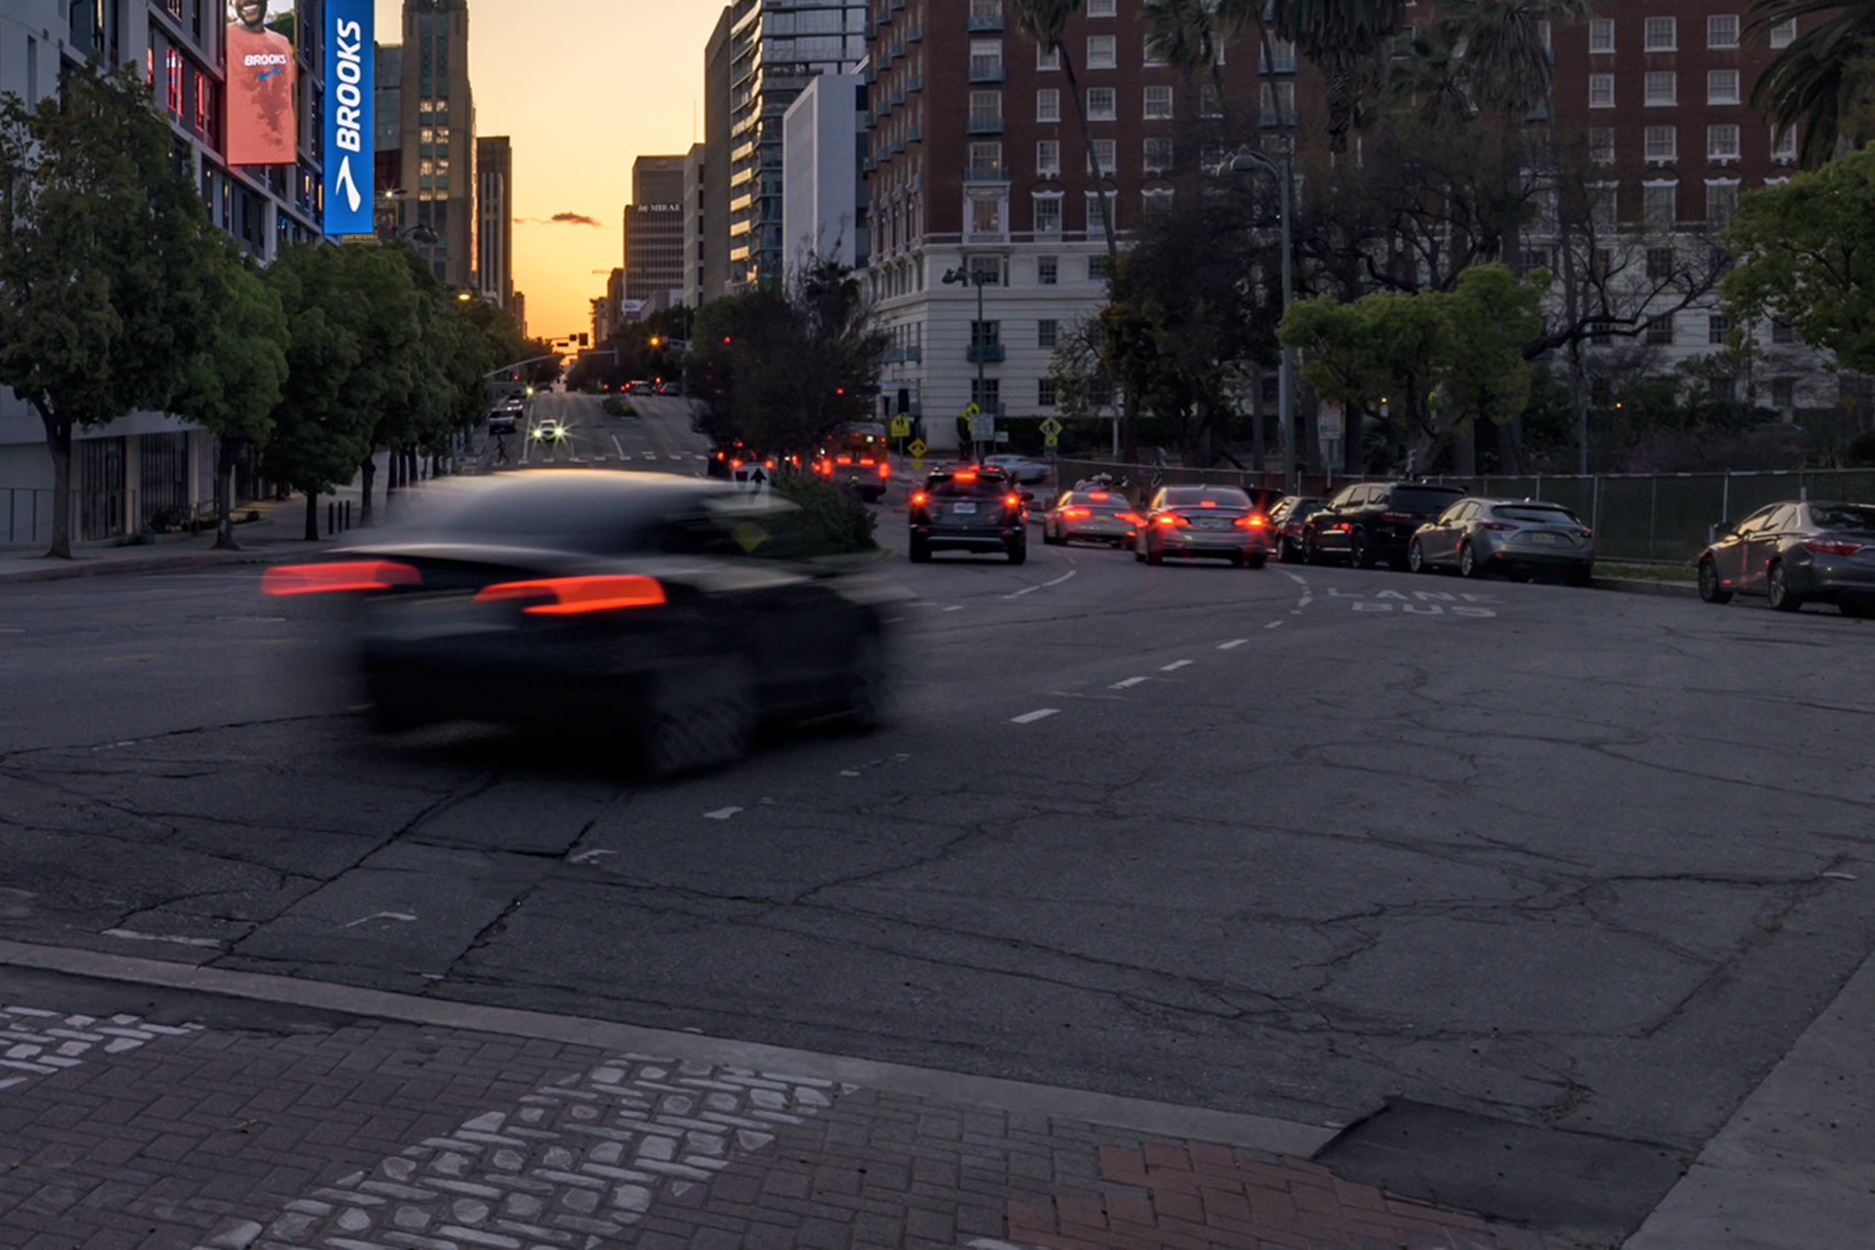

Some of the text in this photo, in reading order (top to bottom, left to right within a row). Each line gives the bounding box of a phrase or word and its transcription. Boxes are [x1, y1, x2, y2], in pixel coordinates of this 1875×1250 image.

[244, 53, 287, 66] BROOKS
[336, 17, 361, 153] BROOKS
[1327, 587, 1507, 604] LANE
[1351, 601, 1498, 618] BUS
